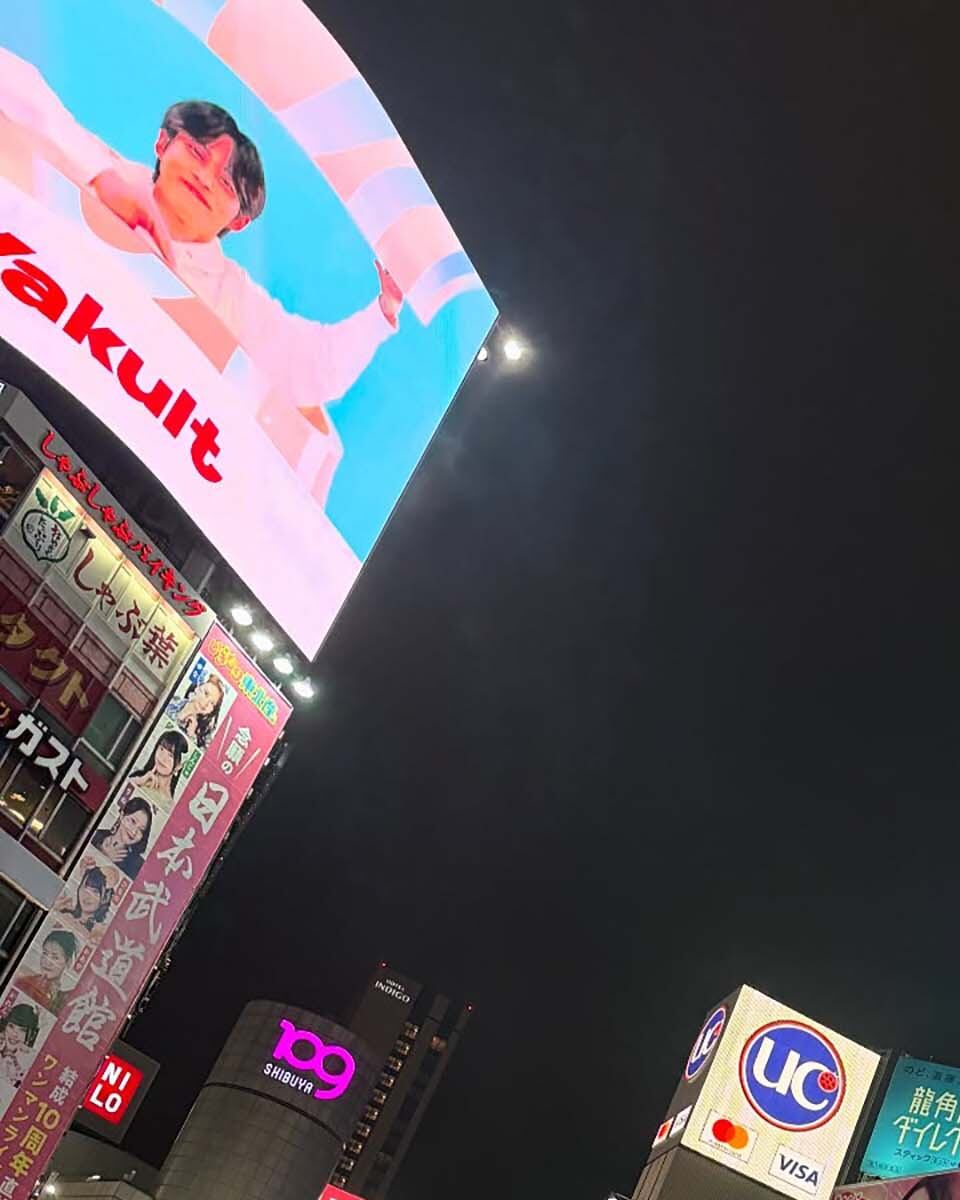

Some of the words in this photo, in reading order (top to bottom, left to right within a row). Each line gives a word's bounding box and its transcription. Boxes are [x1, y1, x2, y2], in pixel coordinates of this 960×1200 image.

[0, 232, 224, 485] akult
[73, 547, 179, 669] しゃぶ葉
[5, 711, 90, 794] ガスト
[60, 781, 230, 1053] 日本武道館
[374, 980, 411, 1004] INDIGO
[102, 1062, 131, 1091] NI
[263, 1063, 315, 1095] SHIBUYA
[273, 1019, 356, 1101] 109
[89, 1084, 122, 1113] LO
[780, 1154, 820, 1187] VISA
